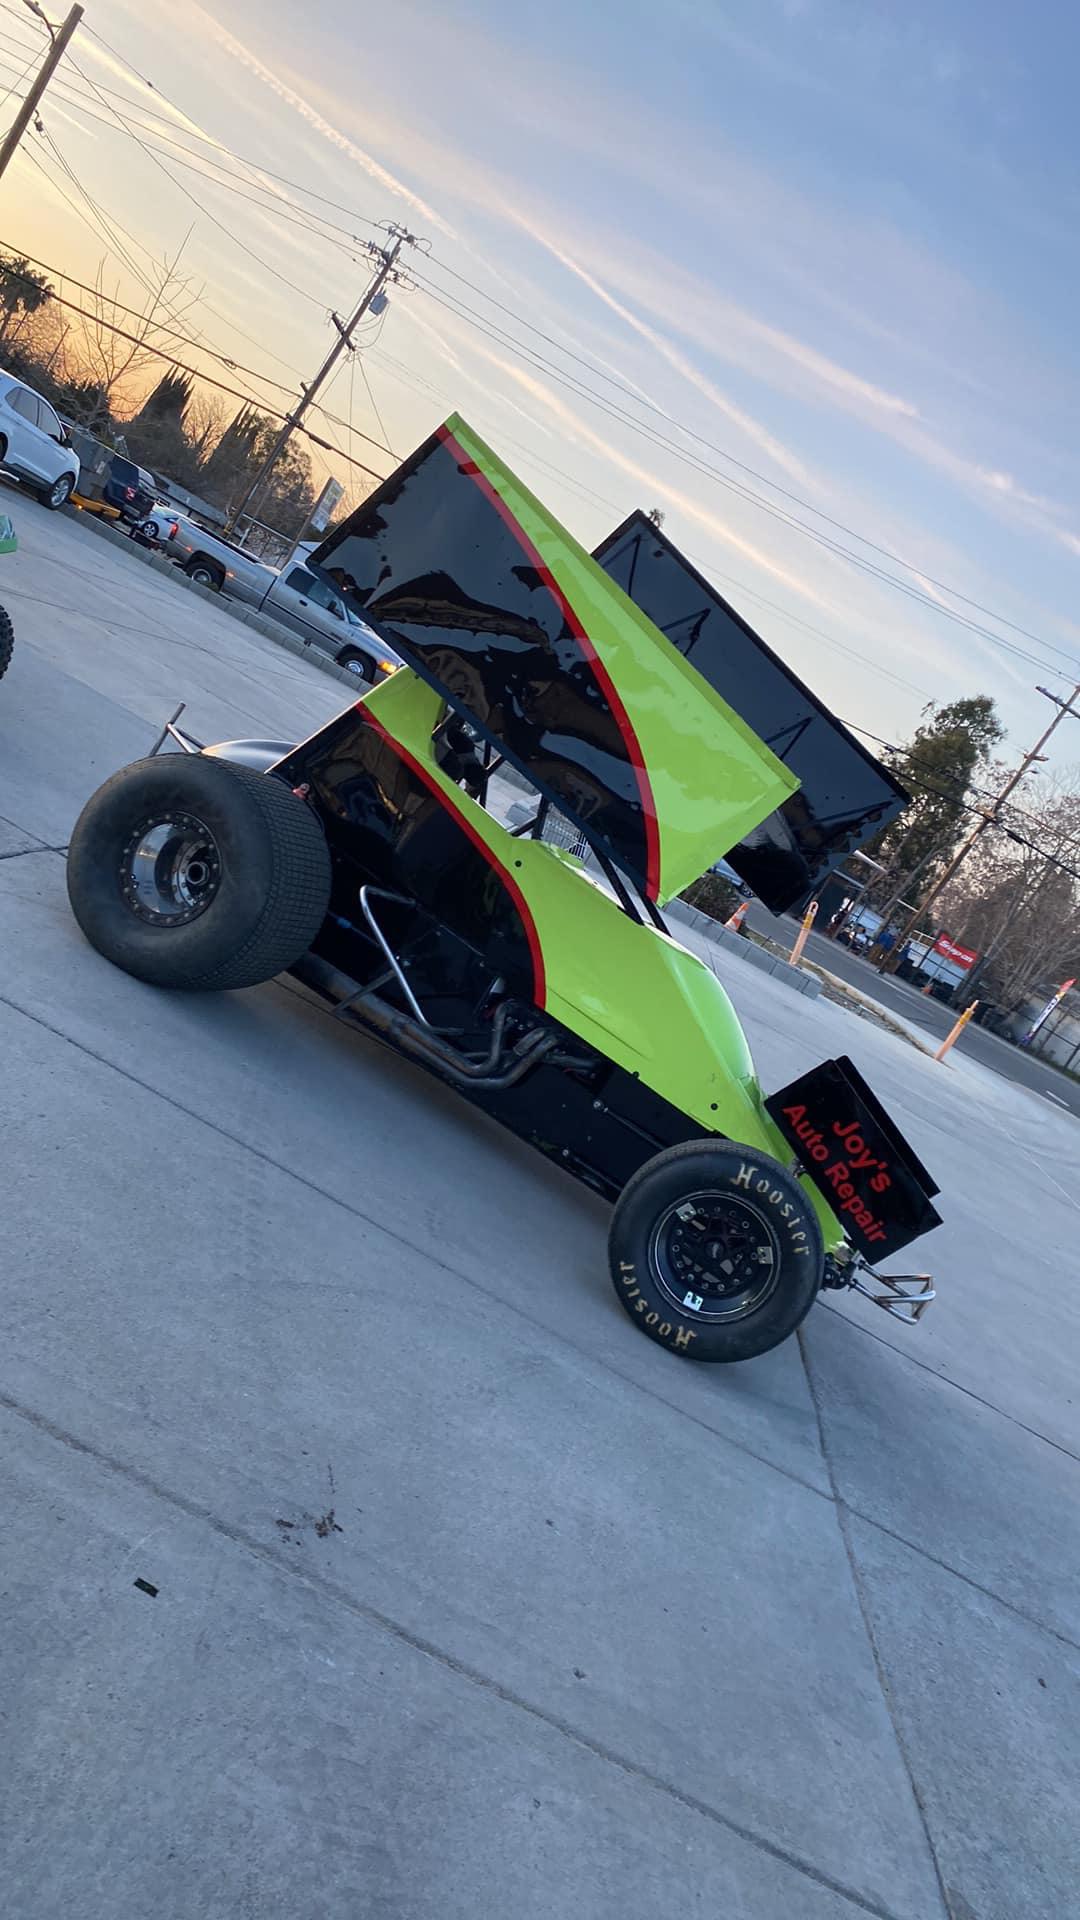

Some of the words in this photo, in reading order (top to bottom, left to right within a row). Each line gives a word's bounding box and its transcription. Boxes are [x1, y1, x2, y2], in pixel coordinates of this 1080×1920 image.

[782, 1105, 829, 1161] Auto
[825, 1161, 887, 1241] Repair
[833, 1121, 891, 1191] Joy's
[731, 1163, 810, 1255] Hoosier
[619, 1261, 697, 1349] Hoosier
